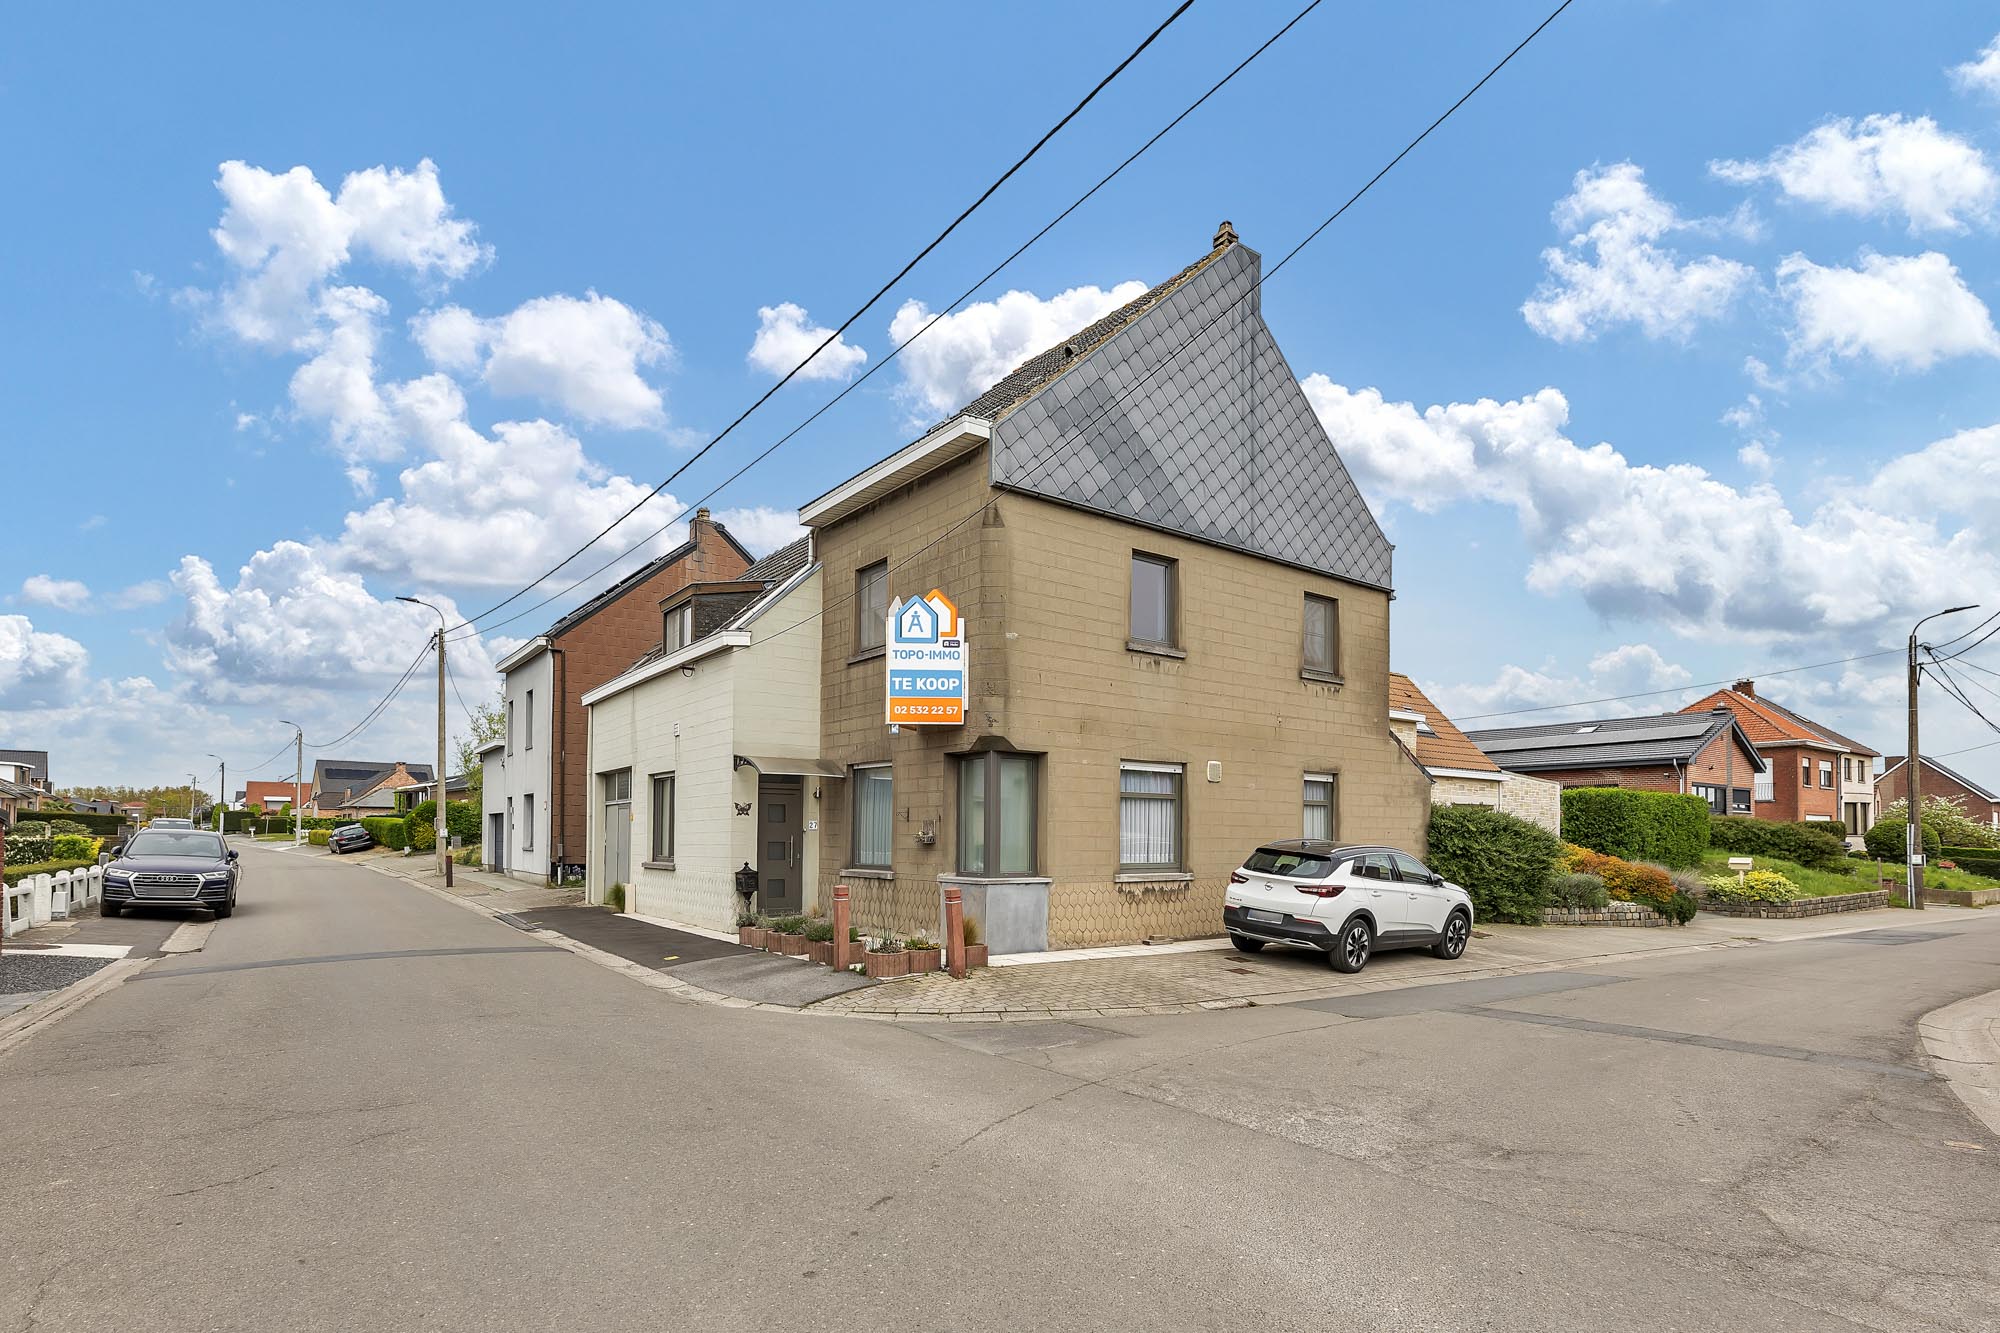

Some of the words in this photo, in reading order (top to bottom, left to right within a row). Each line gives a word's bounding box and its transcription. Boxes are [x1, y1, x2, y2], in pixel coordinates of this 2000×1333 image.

[892, 649, 961, 660] TOPO-IMMO
[892, 677, 912, 690] TE
[916, 677, 960, 690] KOOP
[894, 705, 908, 714] 02
[909, 705, 929, 714] 532
[931, 705, 944, 714] 22
[946, 706, 958, 715] 57
[809, 821, 817, 829] 27
